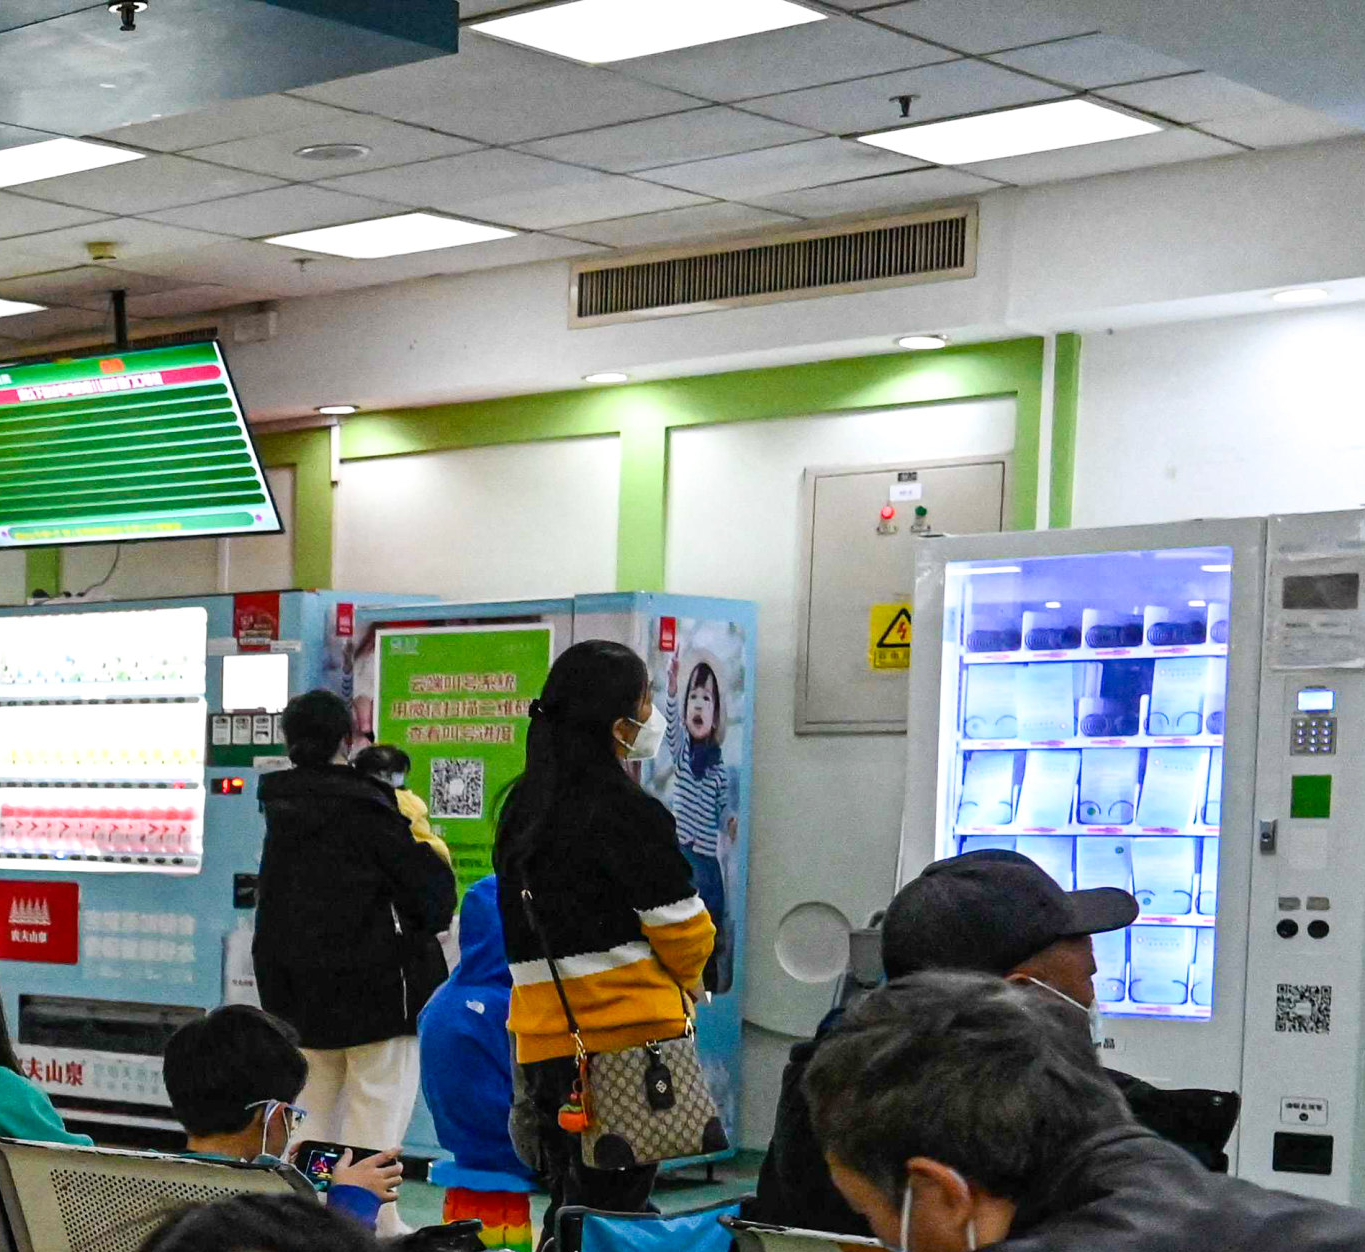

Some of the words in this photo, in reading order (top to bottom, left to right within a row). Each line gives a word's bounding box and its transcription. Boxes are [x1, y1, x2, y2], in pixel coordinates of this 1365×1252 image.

[410, 672, 517, 693] 云端叫号系统
[19, 1056, 84, 1087] 夫山泉
